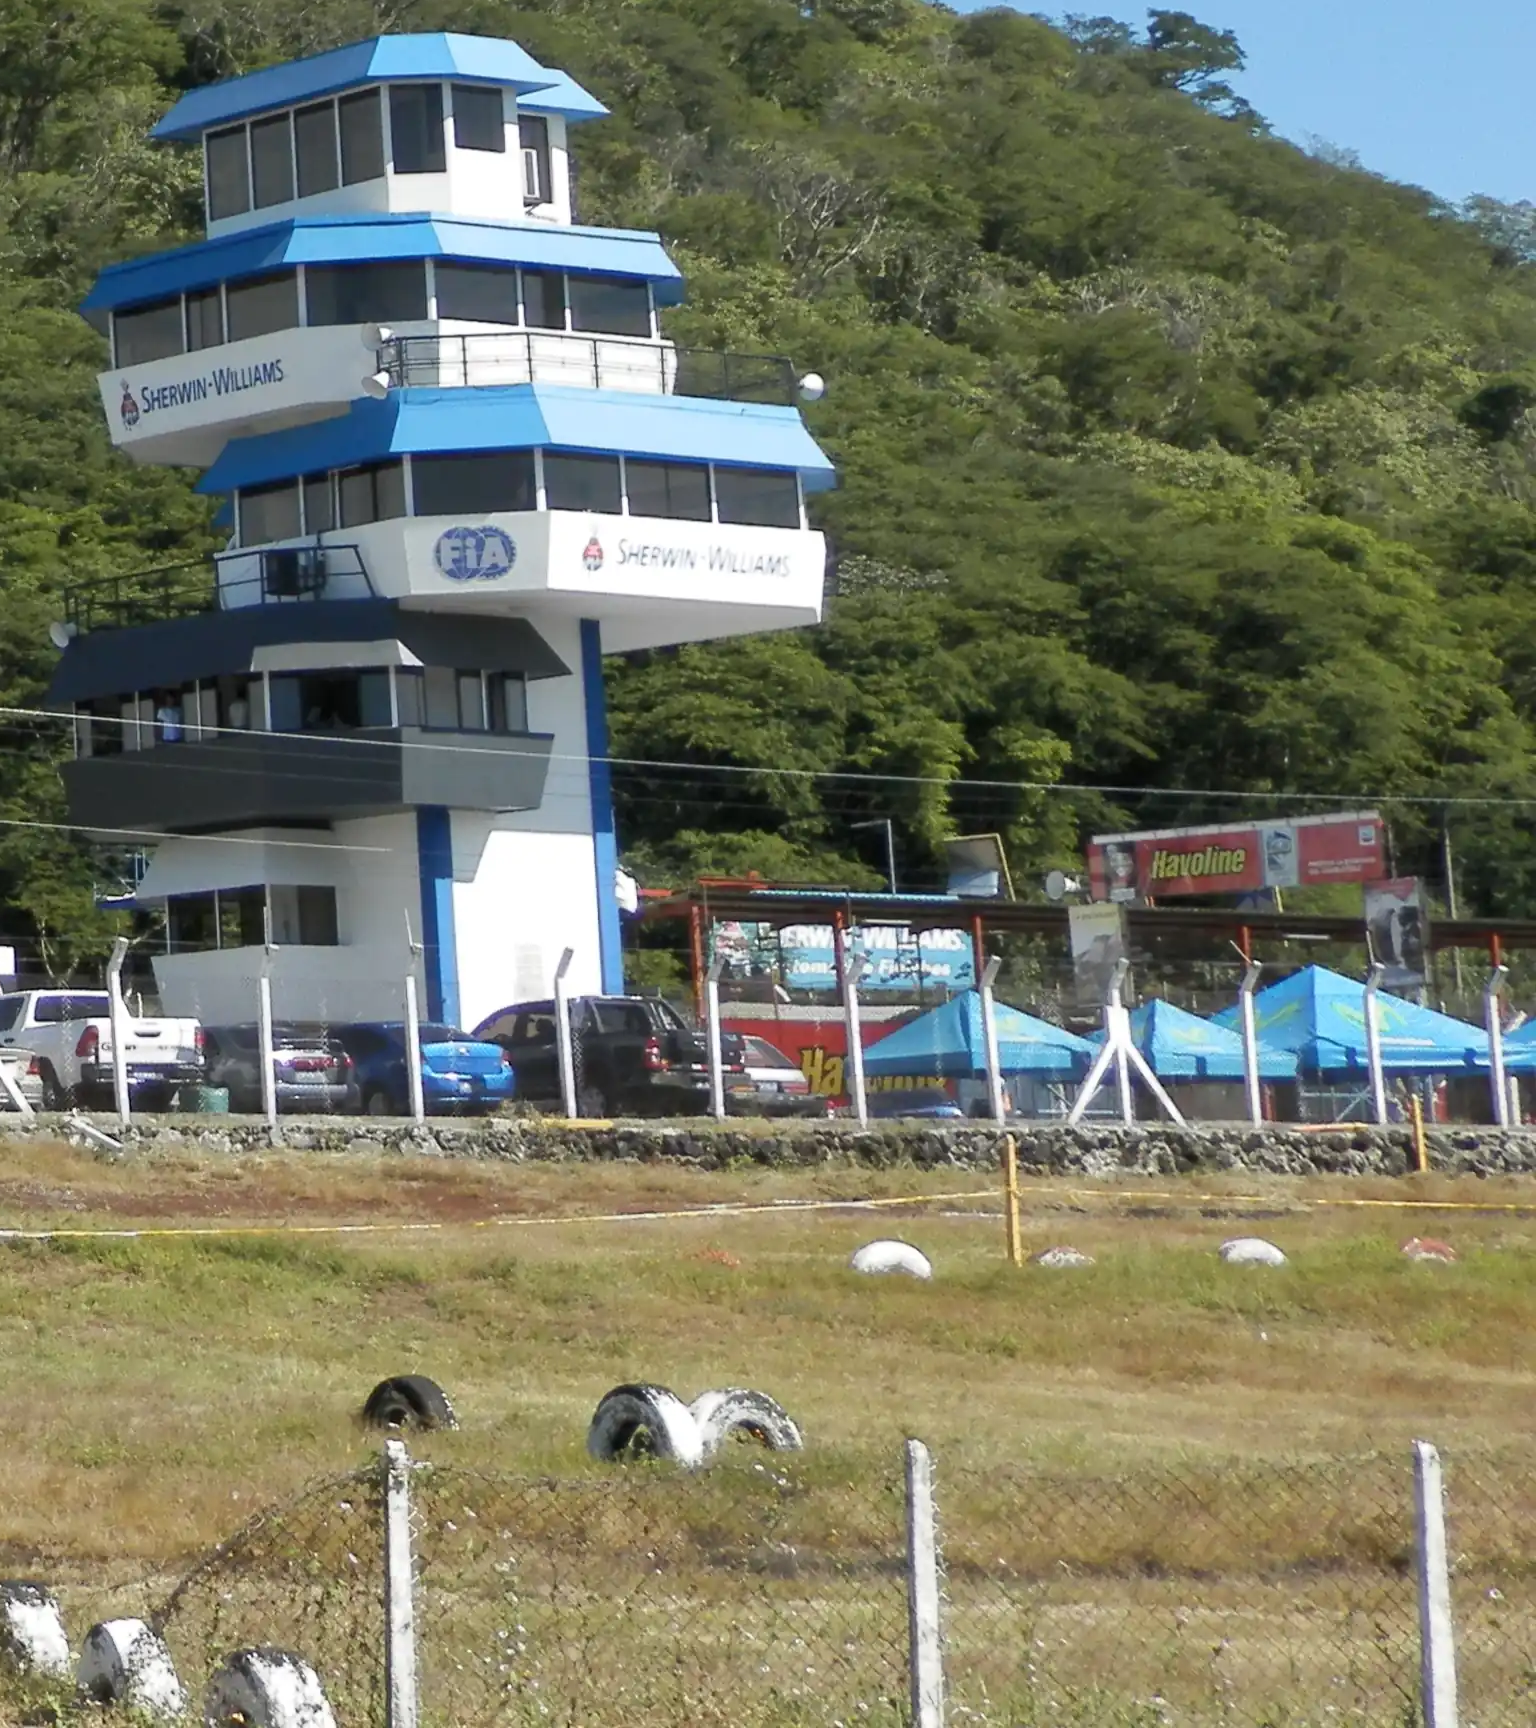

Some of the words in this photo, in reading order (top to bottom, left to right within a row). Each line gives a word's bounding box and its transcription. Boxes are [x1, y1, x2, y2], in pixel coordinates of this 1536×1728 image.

[141, 359, 284, 413] SHERWIN-WILLIAMS
[617, 538, 791, 577] SHERWIN-WILLIAMS
[1151, 845, 1247, 880] Havoline
